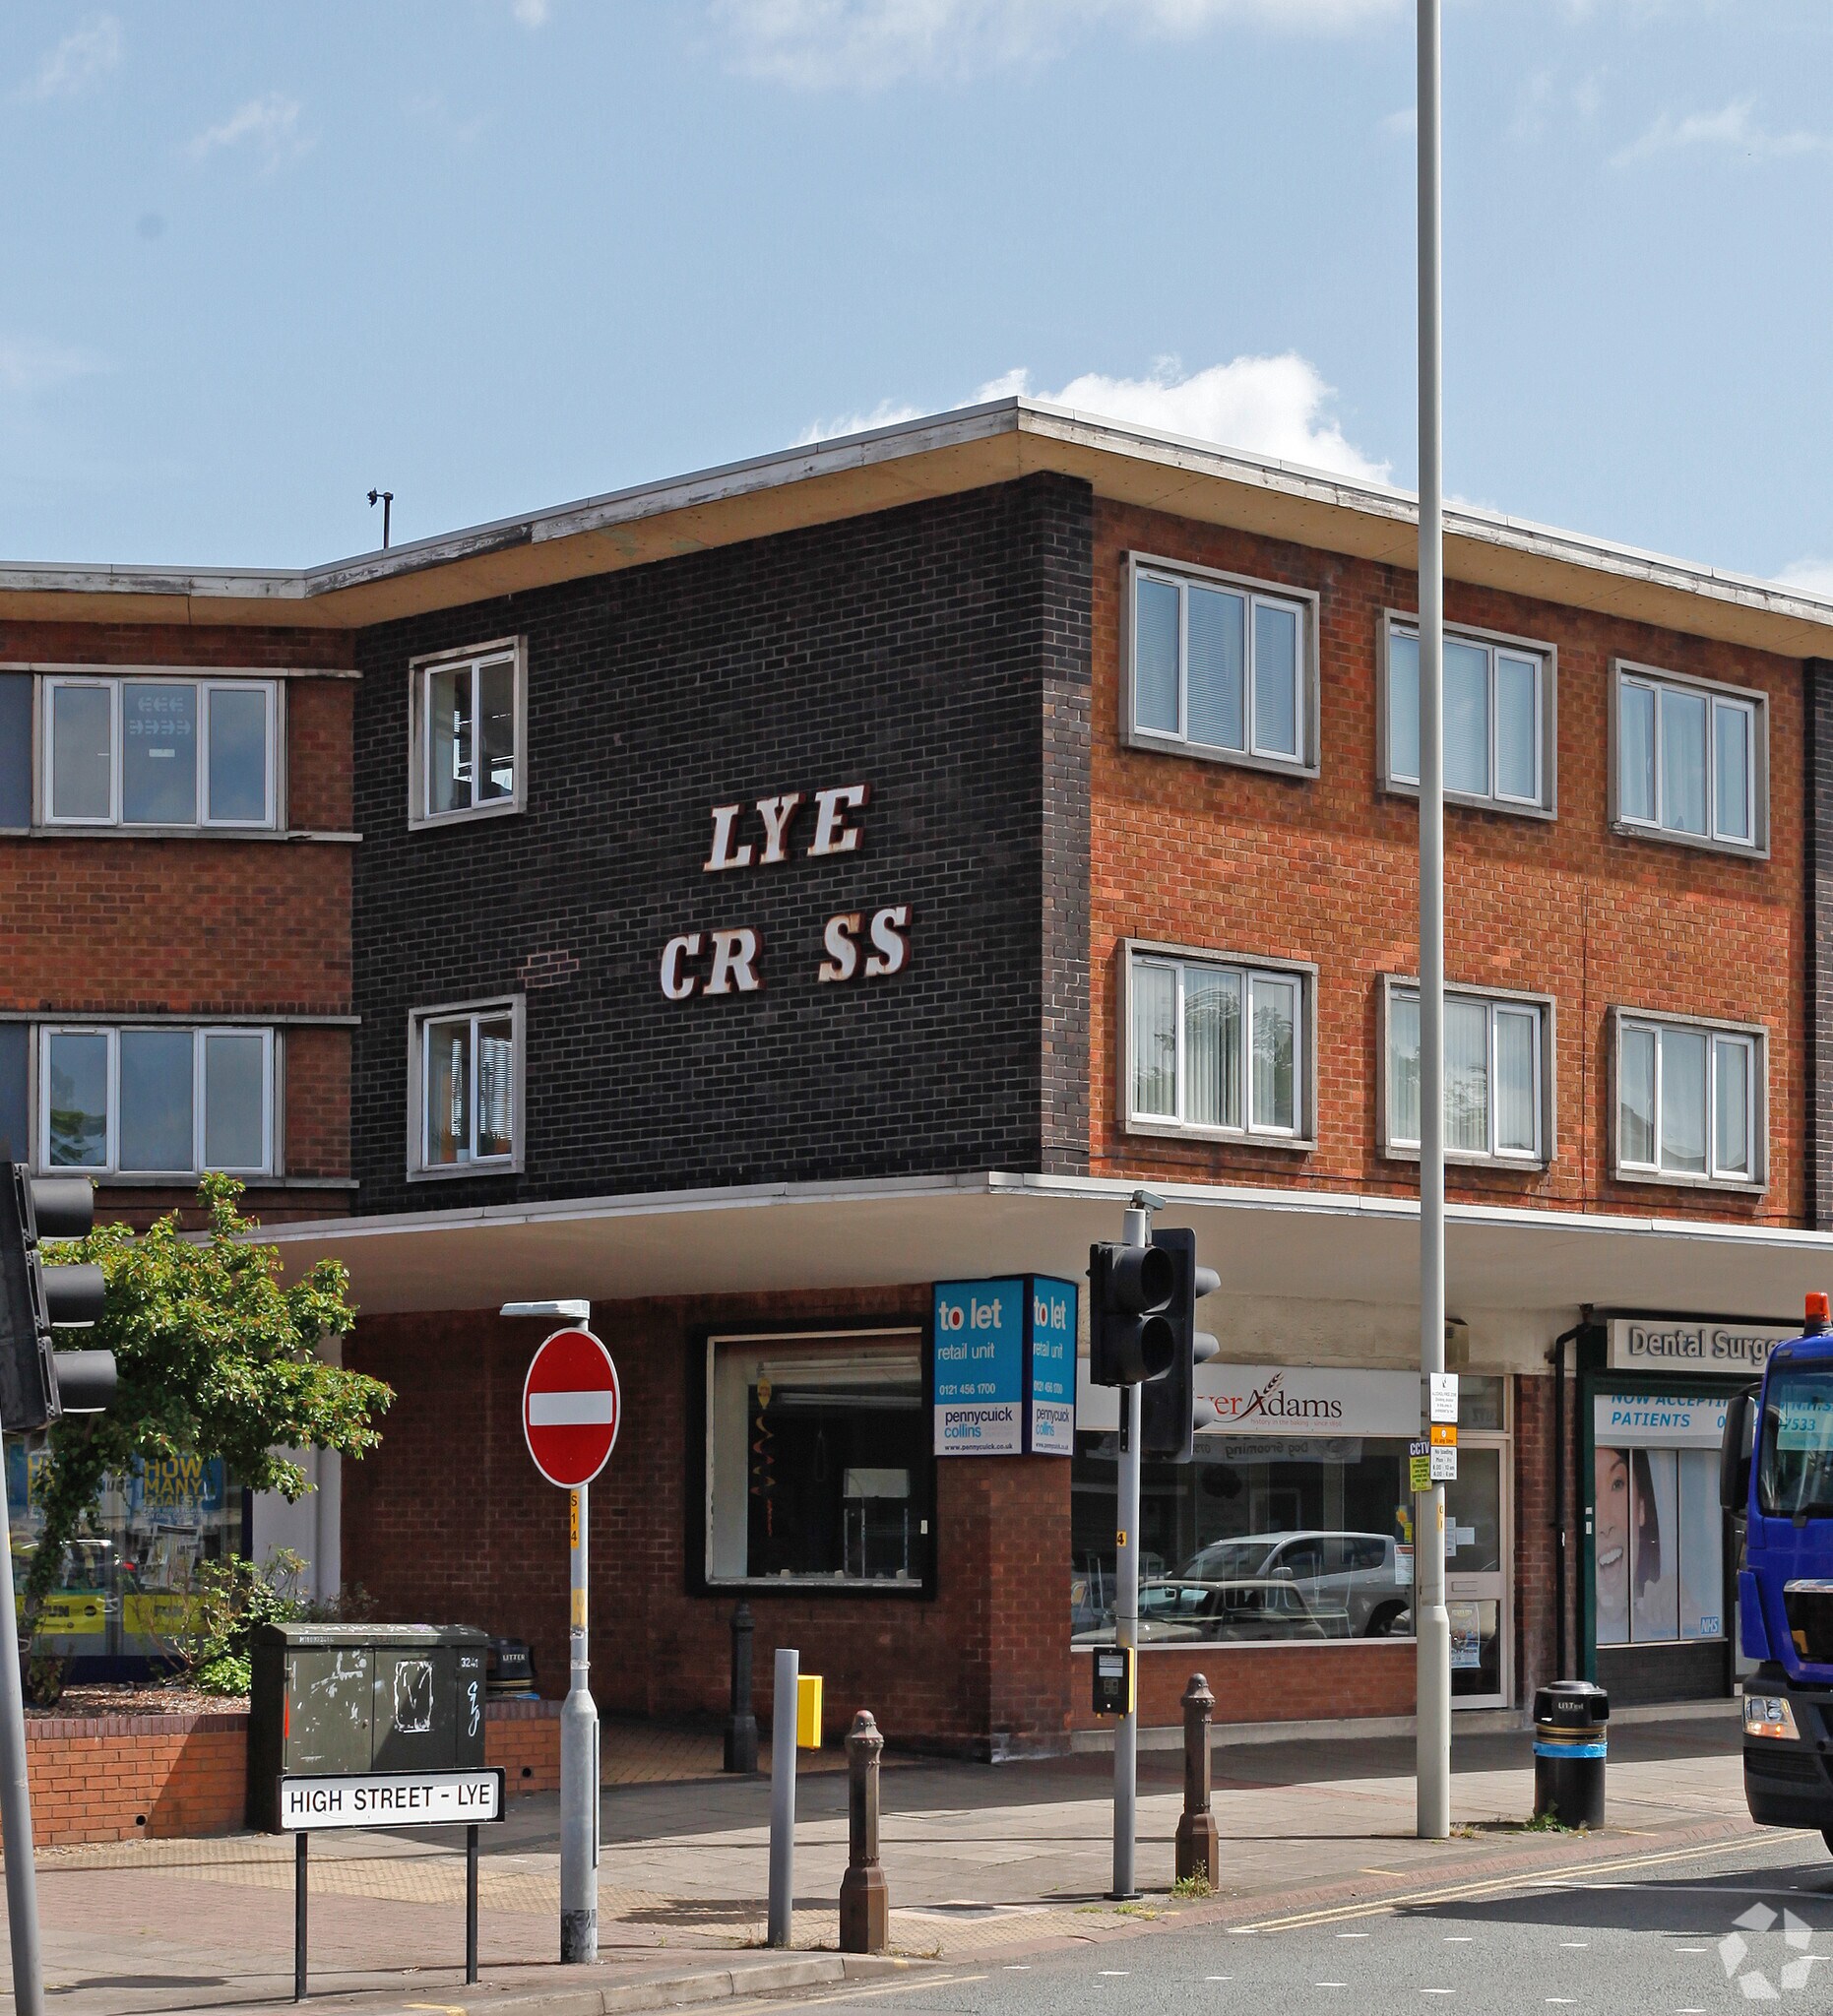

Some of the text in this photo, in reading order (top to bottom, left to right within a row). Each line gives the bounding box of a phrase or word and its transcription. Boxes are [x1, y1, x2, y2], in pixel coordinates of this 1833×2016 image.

[703, 784, 871, 872] LYE
[939, 1297, 1002, 1330] to let
[1035, 1295, 1066, 1330] to let
[938, 1342, 995, 1359] retail unit
[1034, 1341, 1063, 1359] retail unit
[1630, 1326, 1784, 1366] Dental Surge
[940, 1383, 995, 1395] 0121 456 1700
[1655, 1396, 1728, 1408] ACCEPTI
[945, 1407, 1013, 1425] pennycuick
[1612, 1412, 1690, 1427] PATIENTS
[944, 1424, 981, 1438] collins
[945, 1443, 1013, 1452] www.pennycuick.co.uk
[1410, 1441, 1429, 1456] CCTV
[145, 1456, 204, 1478] HOW
[145, 1478, 203, 1494] MANY
[1701, 1617, 1719, 1633] NHS
[290, 1790, 343, 1813] HIGH
[354, 1786, 433, 1811] STREET
[458, 1784, 490, 1805] LYE
